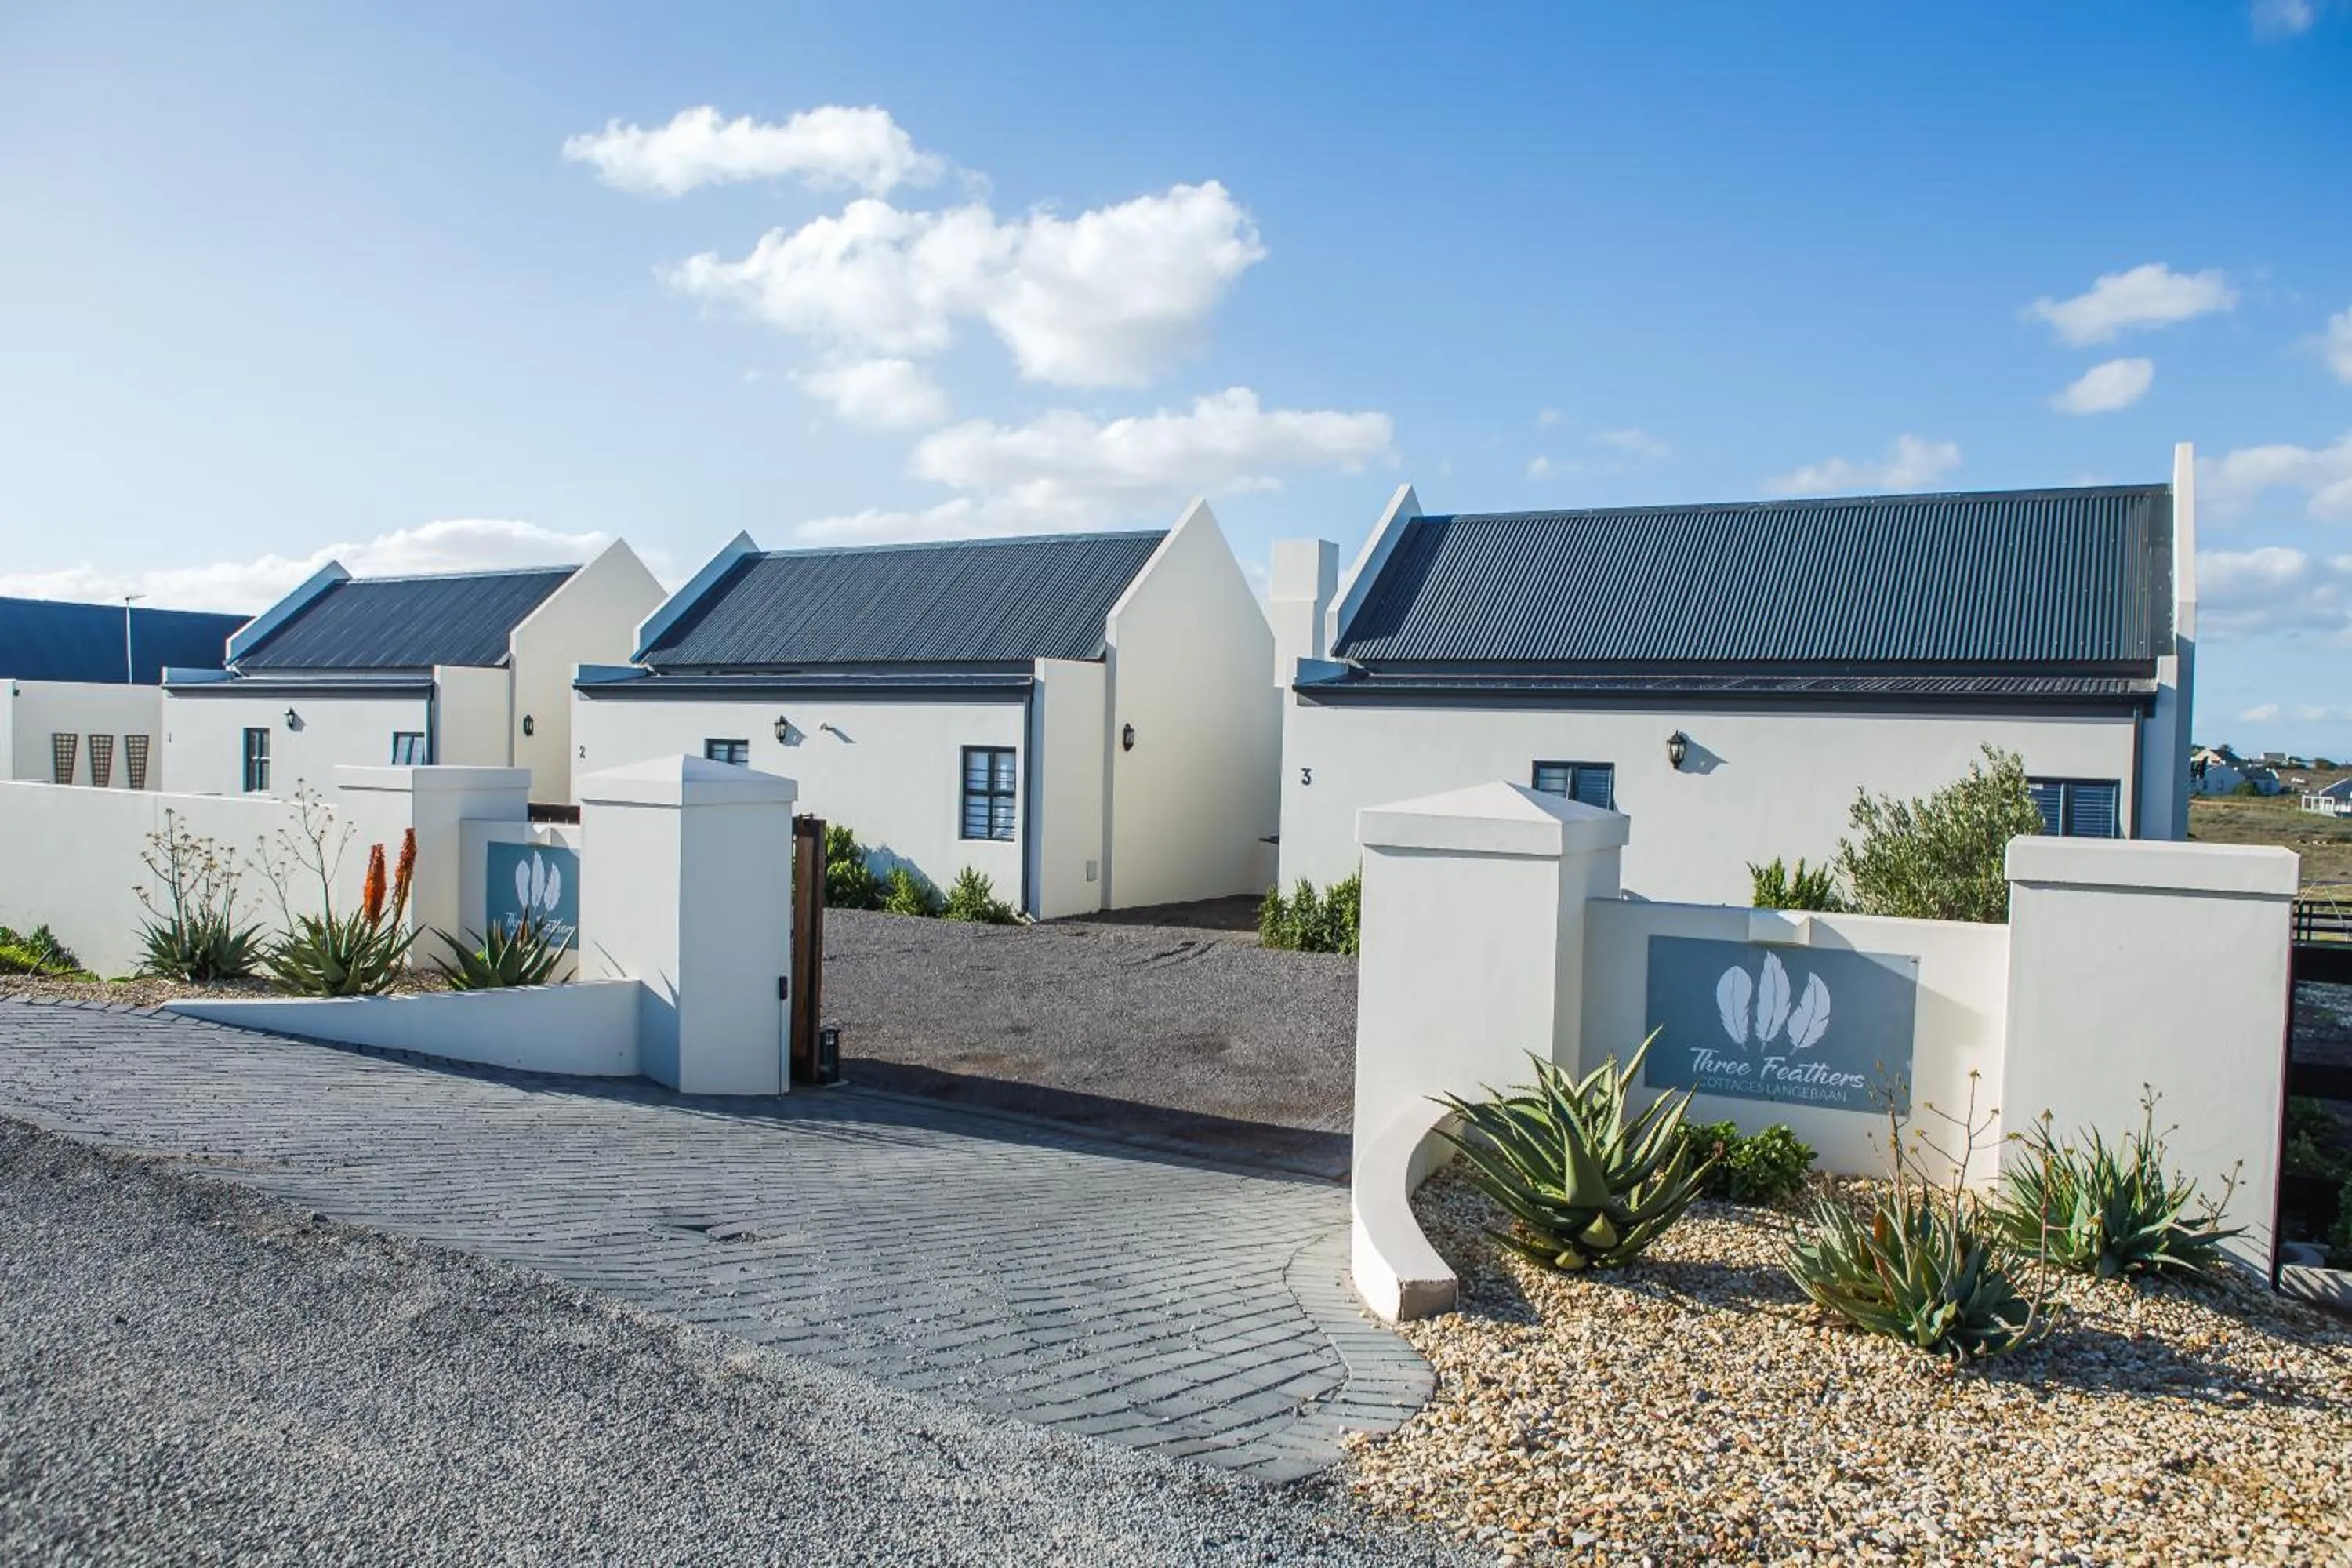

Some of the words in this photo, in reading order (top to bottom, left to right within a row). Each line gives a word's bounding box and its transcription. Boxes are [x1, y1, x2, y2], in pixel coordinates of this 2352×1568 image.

[579, 745, 586, 759] 2
[1301, 768, 1312, 786] 3
[1690, 1047, 1753, 1076] Three
[1760, 1056, 1865, 1088] Feathers
[1700, 1076, 1765, 1093] COTTAGES
[1766, 1083, 1847, 1102] LANGEBAAN
